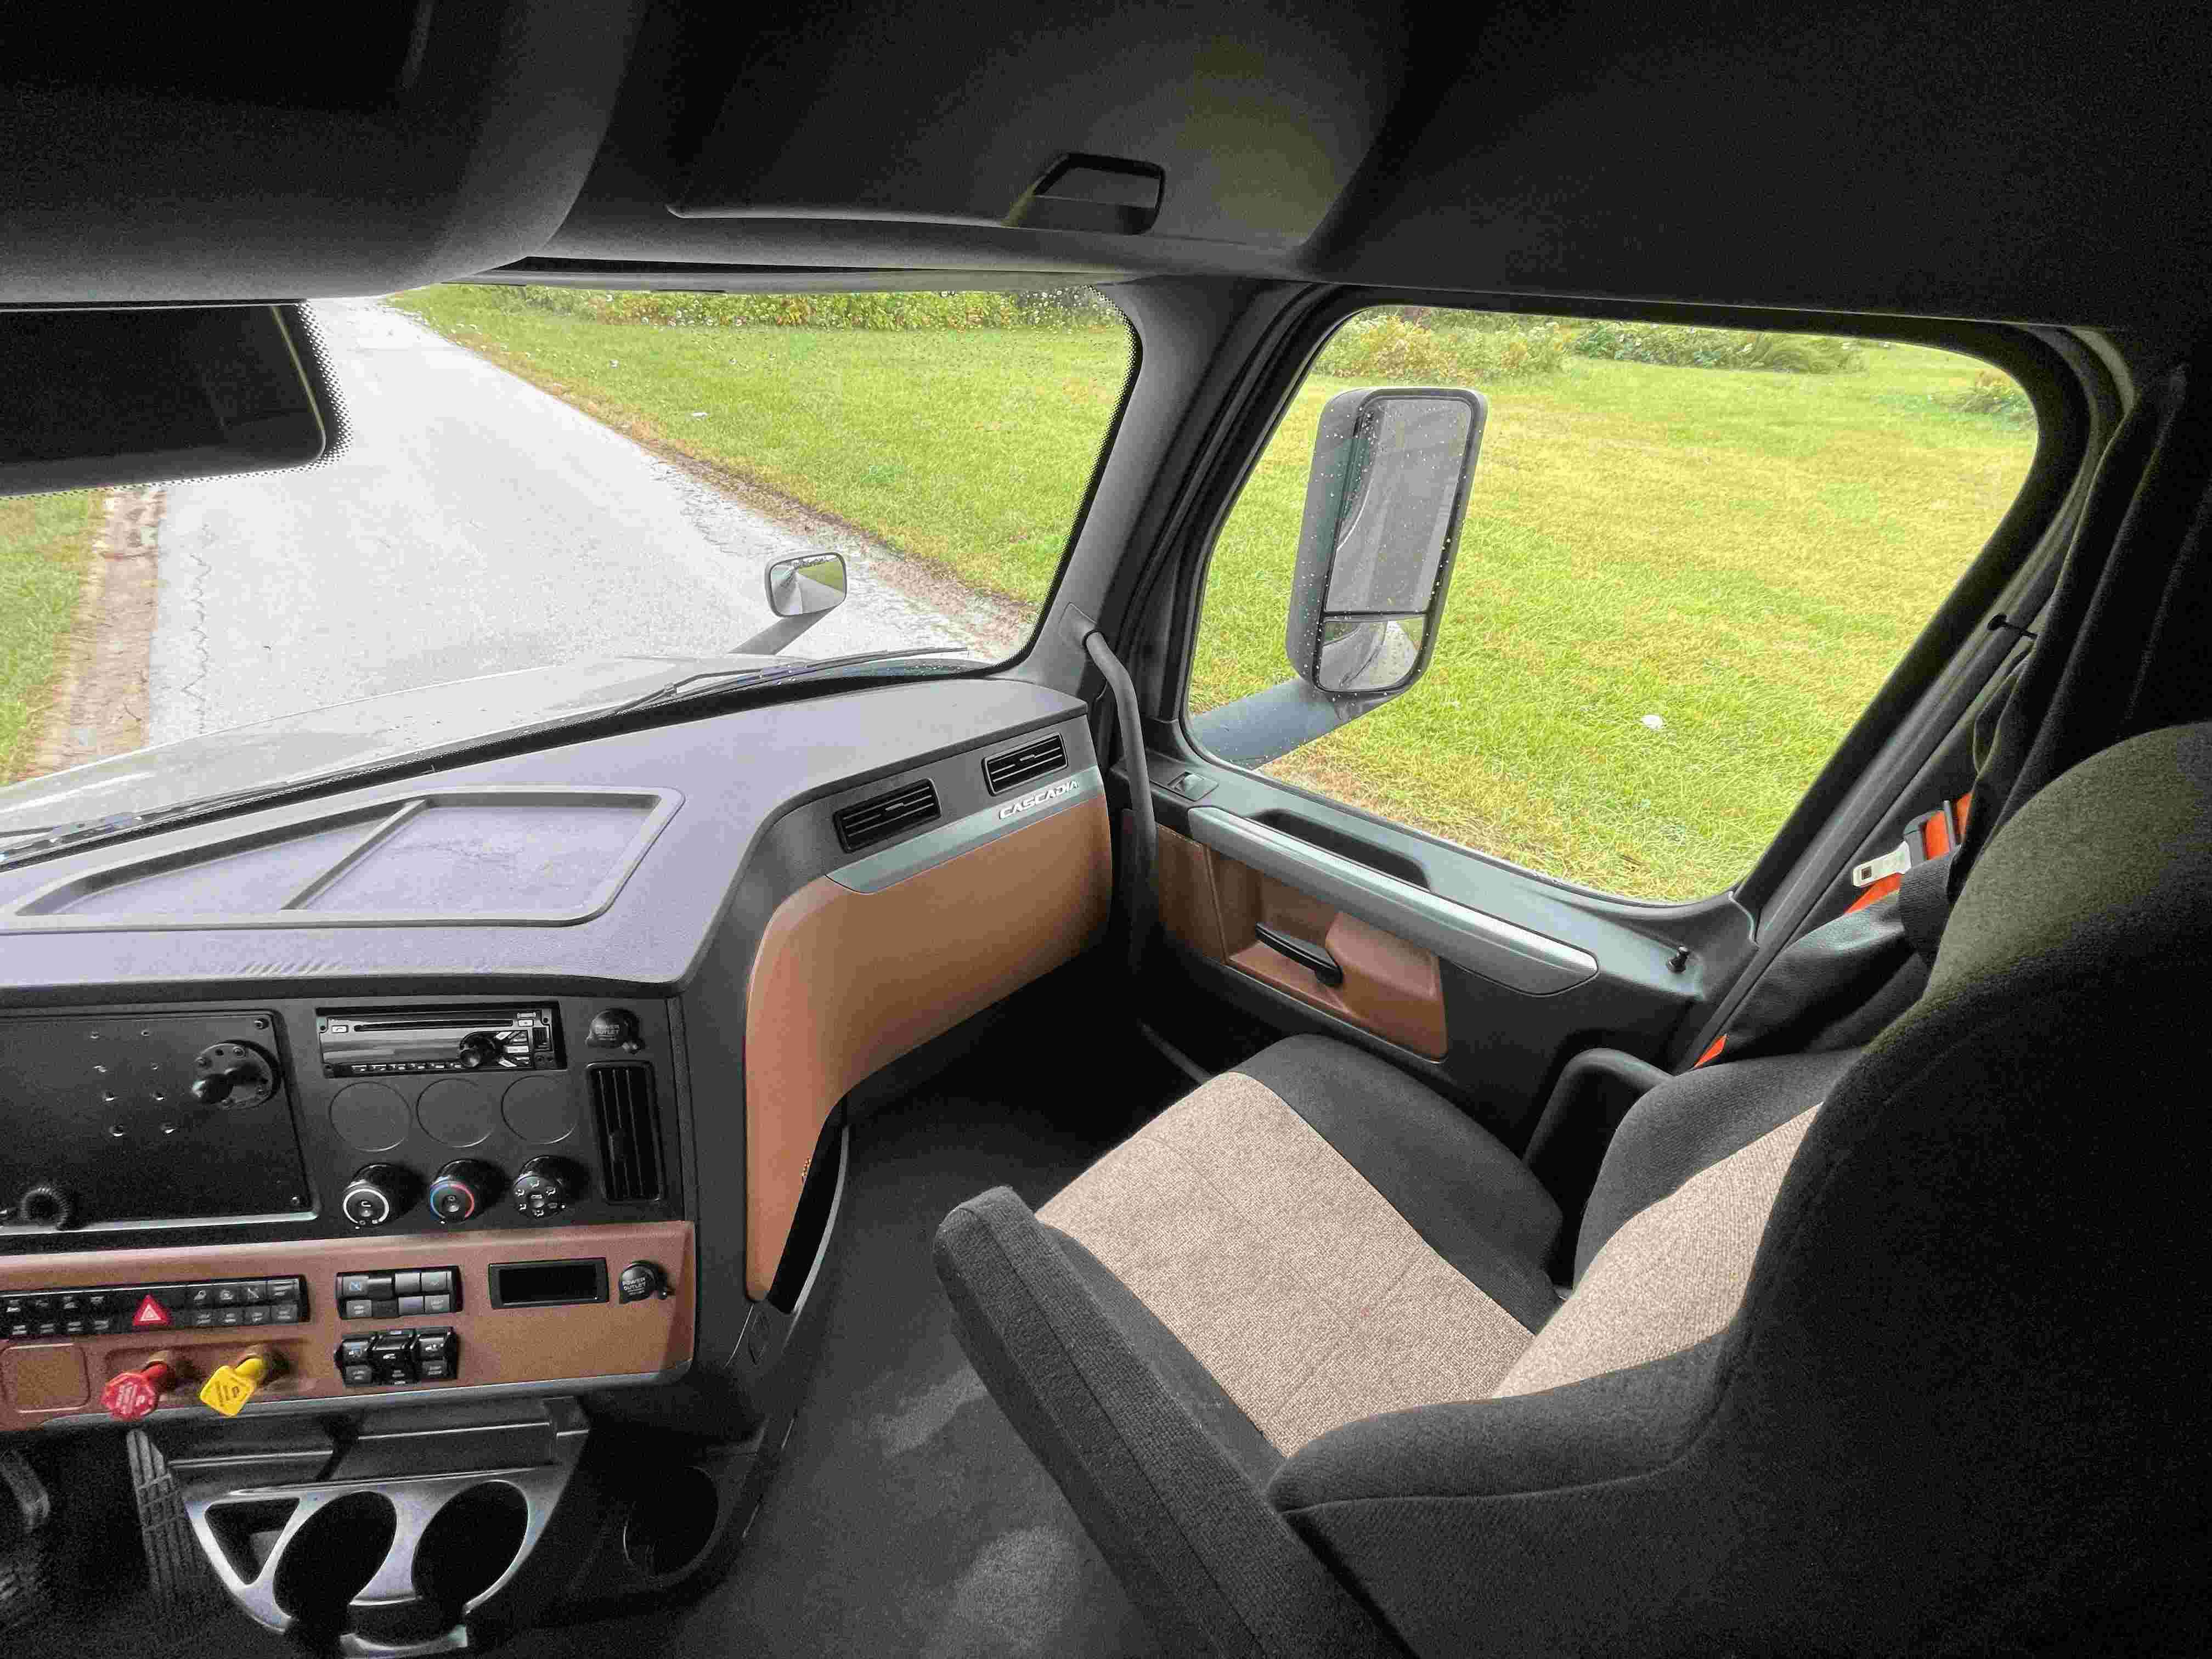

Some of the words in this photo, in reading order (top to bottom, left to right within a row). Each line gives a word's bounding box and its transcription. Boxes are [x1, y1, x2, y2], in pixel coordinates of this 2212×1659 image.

[998, 780, 1080, 820] CASCADIA
[622, 1277, 646, 1285] POWER
[623, 1281, 646, 1291] OUTLET
